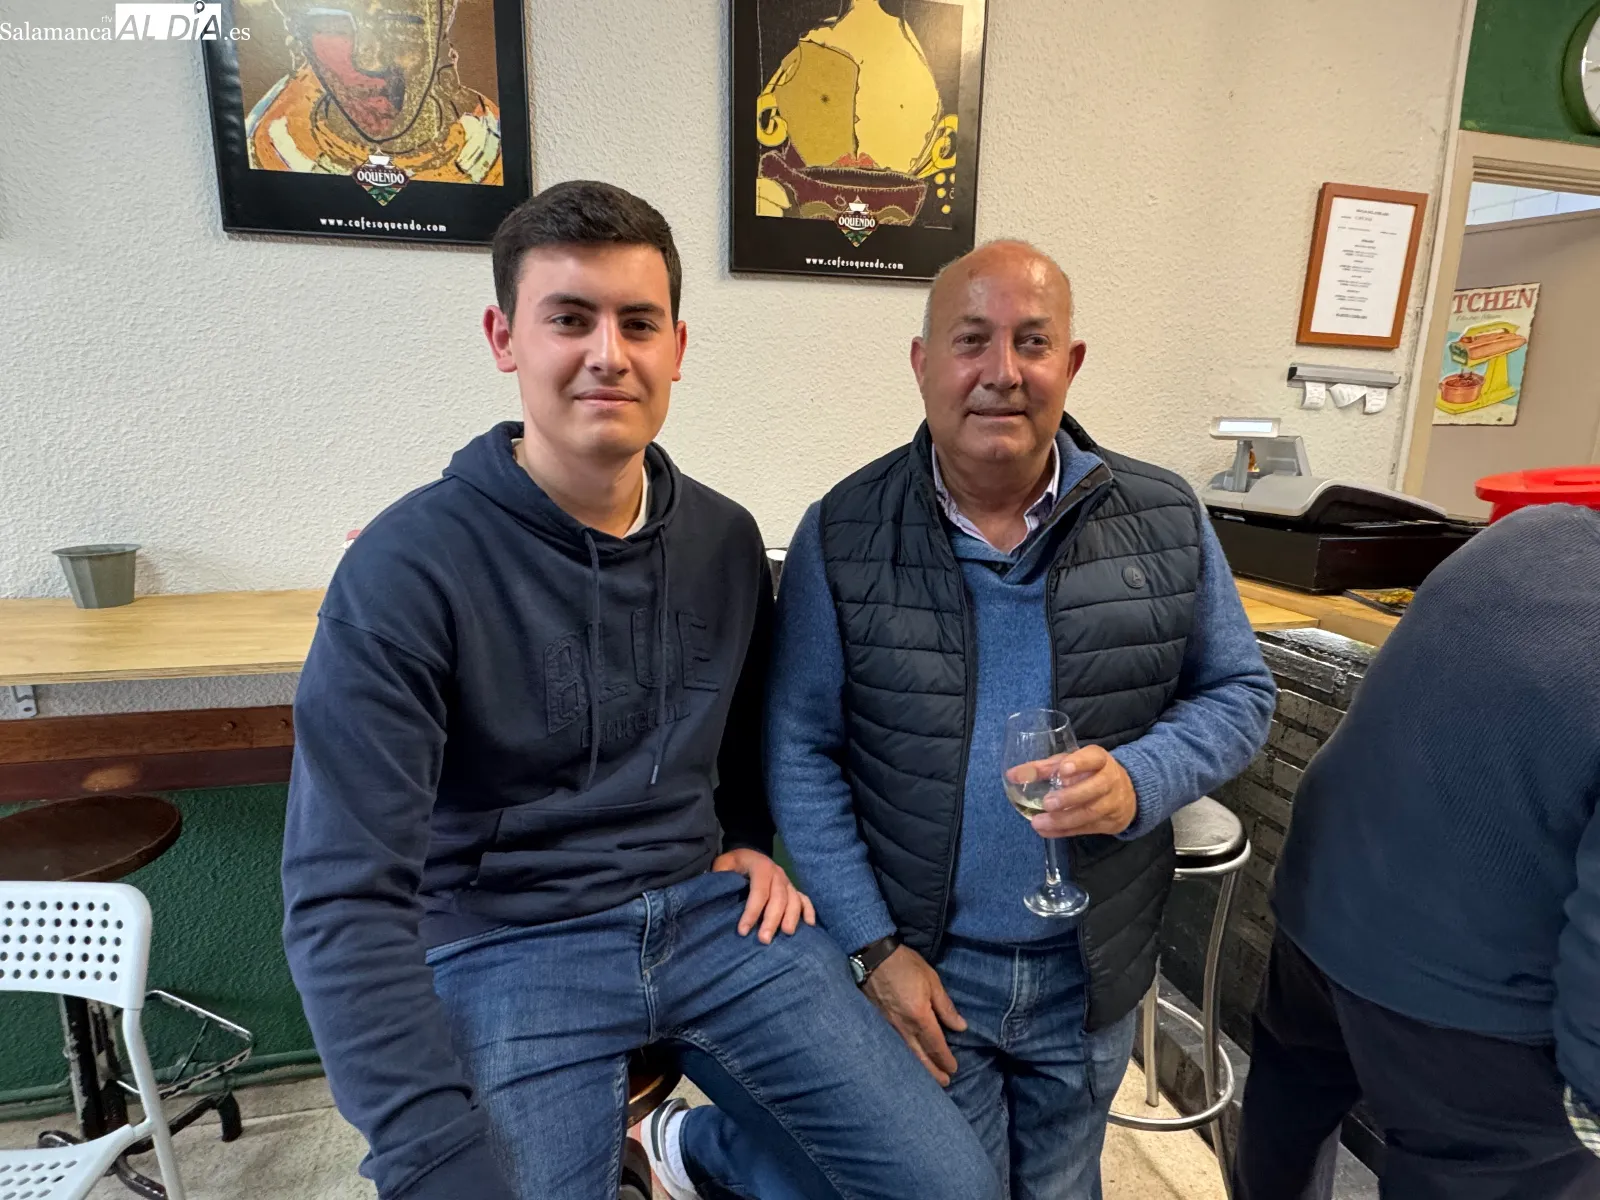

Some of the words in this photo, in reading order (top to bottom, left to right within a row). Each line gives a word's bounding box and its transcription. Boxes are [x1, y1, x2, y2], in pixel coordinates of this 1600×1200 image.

[357, 170, 405, 186] OQUENDO
[319, 216, 447, 233] www.cafesoquendo.com
[838, 215, 876, 230] OQUENDO
[805, 256, 904, 270] www.cafesoquendo.com
[1452, 287, 1537, 314] TCHEN
